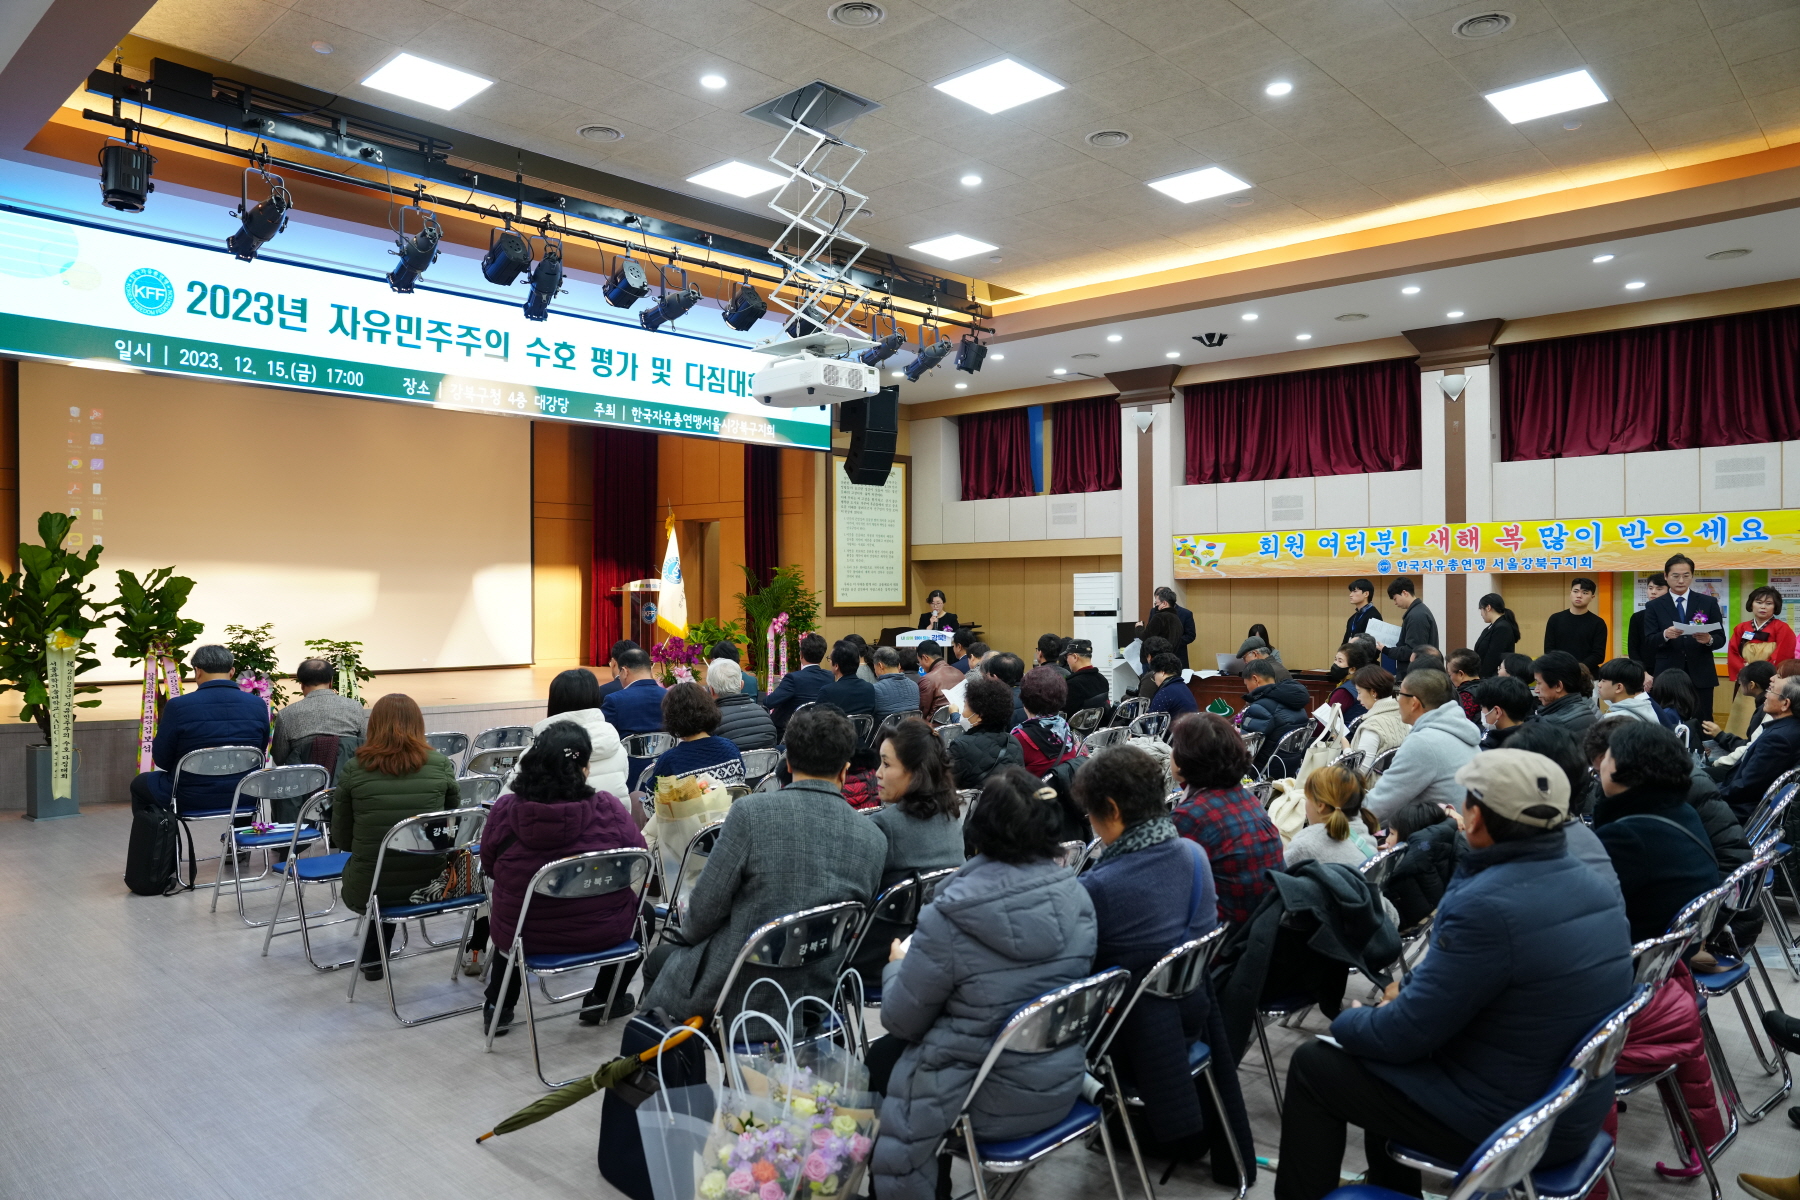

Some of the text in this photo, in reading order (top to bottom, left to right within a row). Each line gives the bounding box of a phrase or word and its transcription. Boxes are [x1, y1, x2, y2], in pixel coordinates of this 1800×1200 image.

[145, 88, 152, 102] 1
[267, 120, 276, 134] 2
[376, 150, 383, 163] 3
[134, 284, 166, 301] KFF
[186, 280, 308, 333] 2023년
[328, 303, 510, 362] 자유민주주의
[526, 336, 576, 371] 수호
[590, 346, 639, 382] 평가
[651, 356, 671, 387] 및
[114, 339, 364, 387] 일시 2023. 12. 15.(금) 17:00
[402, 377, 570, 414] 장소 강북구청 4층 대강당
[593, 402, 616, 420] 주최
[1258, 516, 1769, 559] 회원 여러분! 새해 복 많이 받으세요
[1396, 556, 1593, 573] 한국자유총연맹 서울강북구지회
[433, 824, 459, 837] 강북구
[583, 875, 613, 889] 강북구
[799, 937, 828, 956] 강북구
